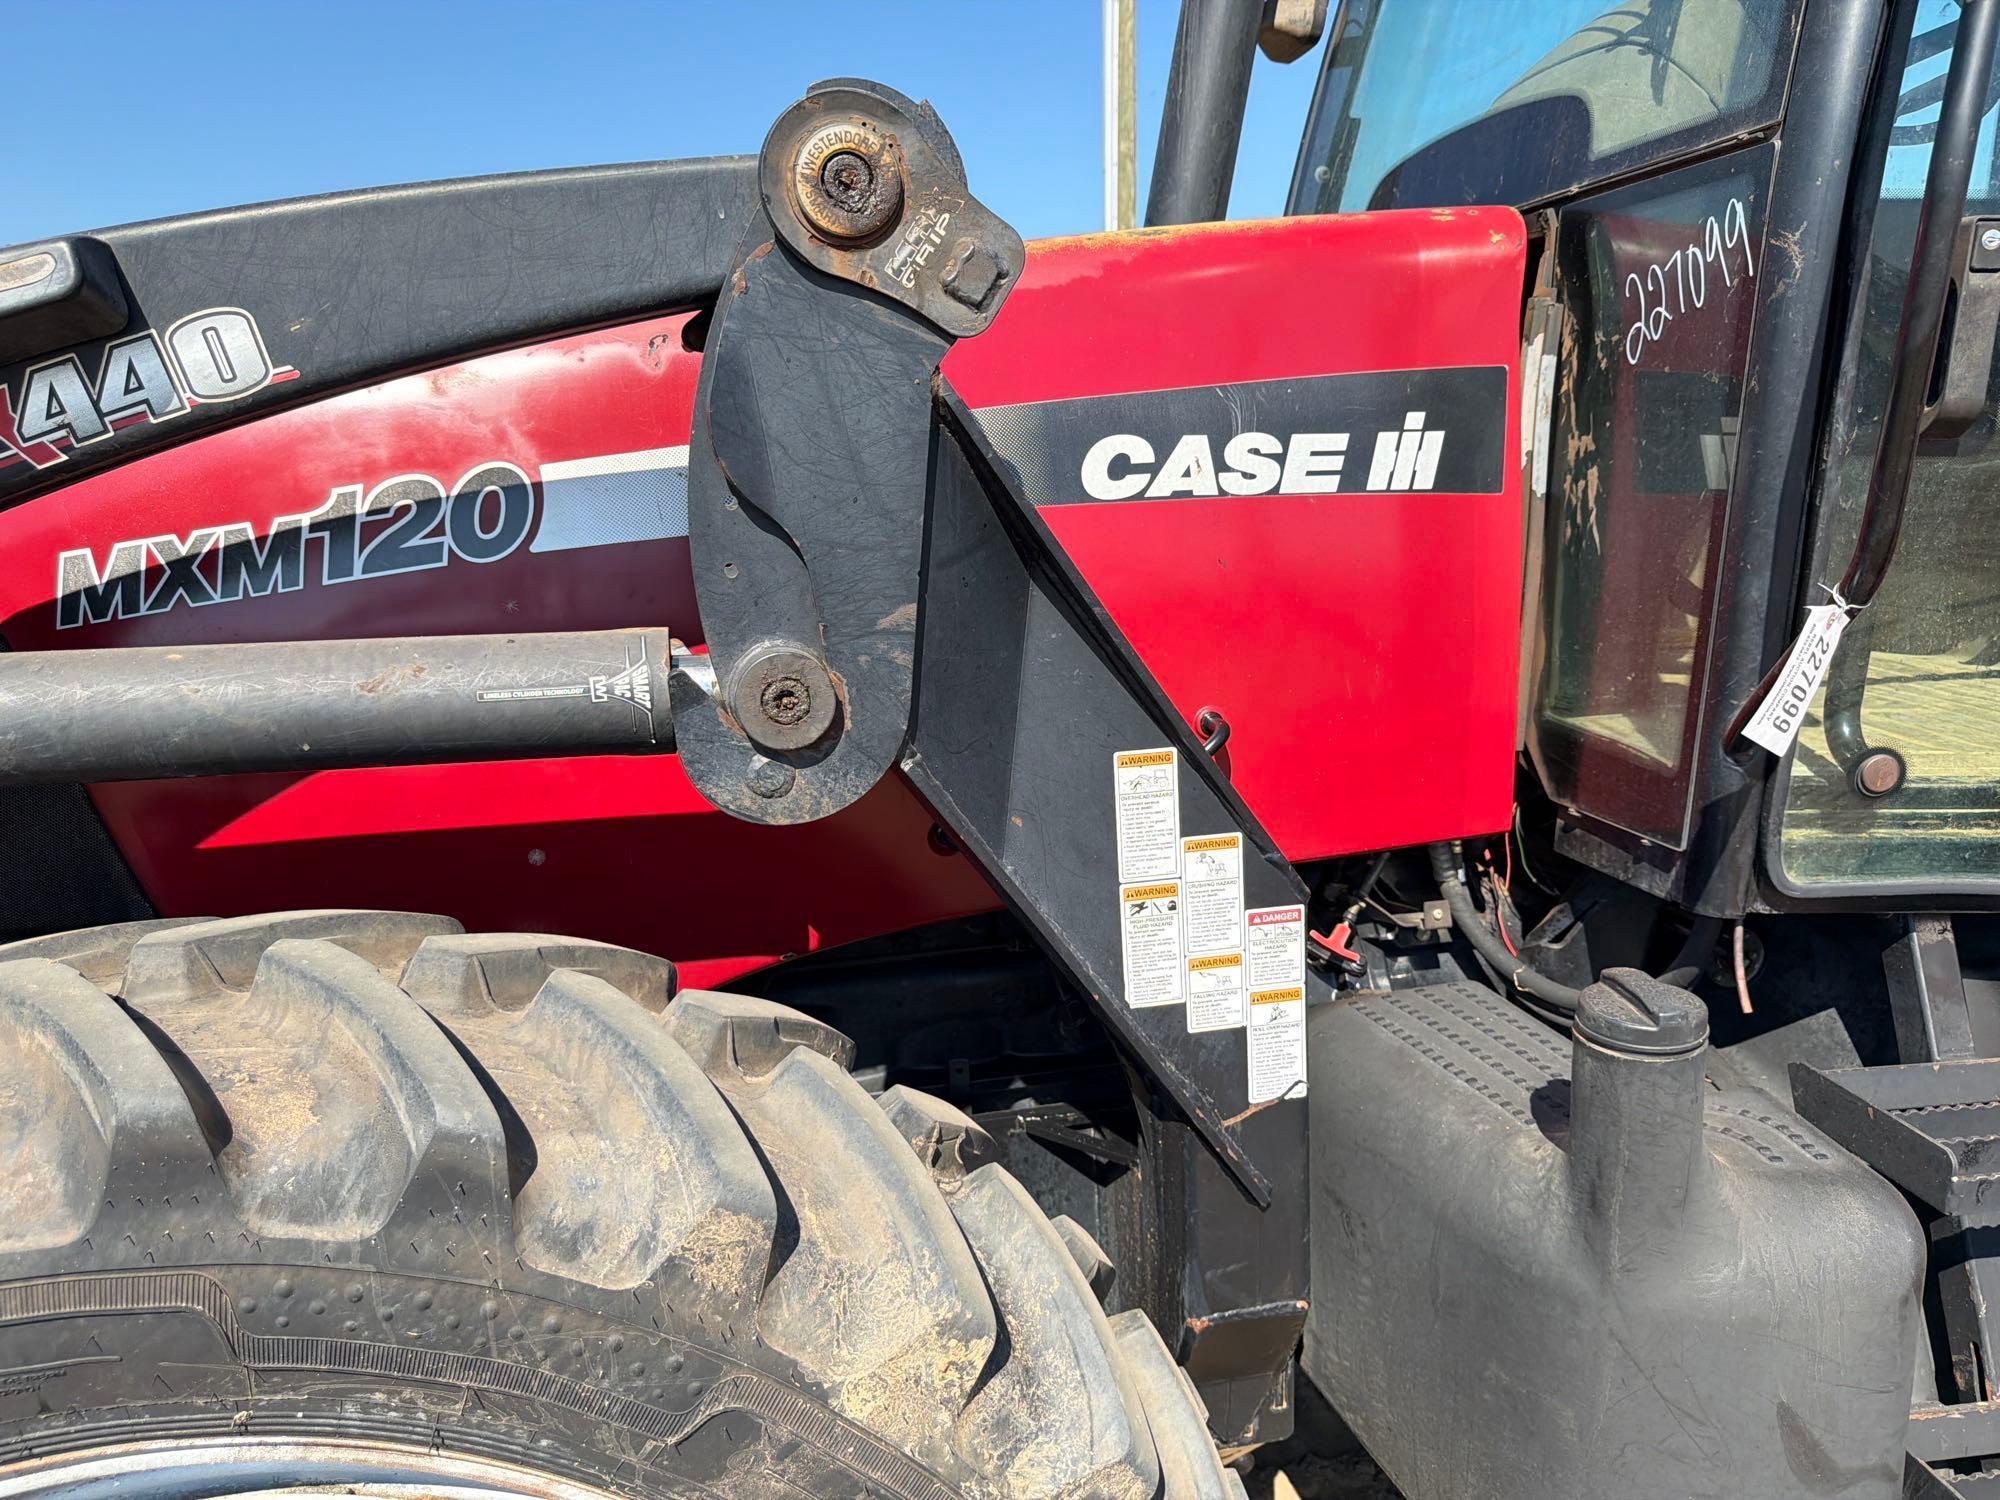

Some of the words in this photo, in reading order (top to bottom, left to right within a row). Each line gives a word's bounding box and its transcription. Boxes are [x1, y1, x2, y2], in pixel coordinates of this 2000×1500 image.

[802, 131, 878, 172] WESTENDORF
[1625, 198, 1754, 365] 227099
[1081, 432, 1350, 500] CASE
[56, 461, 535, 631] MXM120
[614, 676, 631, 698] PAC
[632, 665, 651, 709] SMART
[1772, 634, 1830, 734] 227099
[1786, 657, 1804, 687] AUCTION
[1766, 688, 1788, 721] COMPANY
[1128, 754, 1171, 765] WARNING
[1194, 839, 1236, 849] WARNING
[1133, 886, 1176, 897] WARNING
[1262, 911, 1299, 922] DANGER
[1198, 956, 1239, 967] WARNING
[1259, 990, 1300, 1001] WARNING
